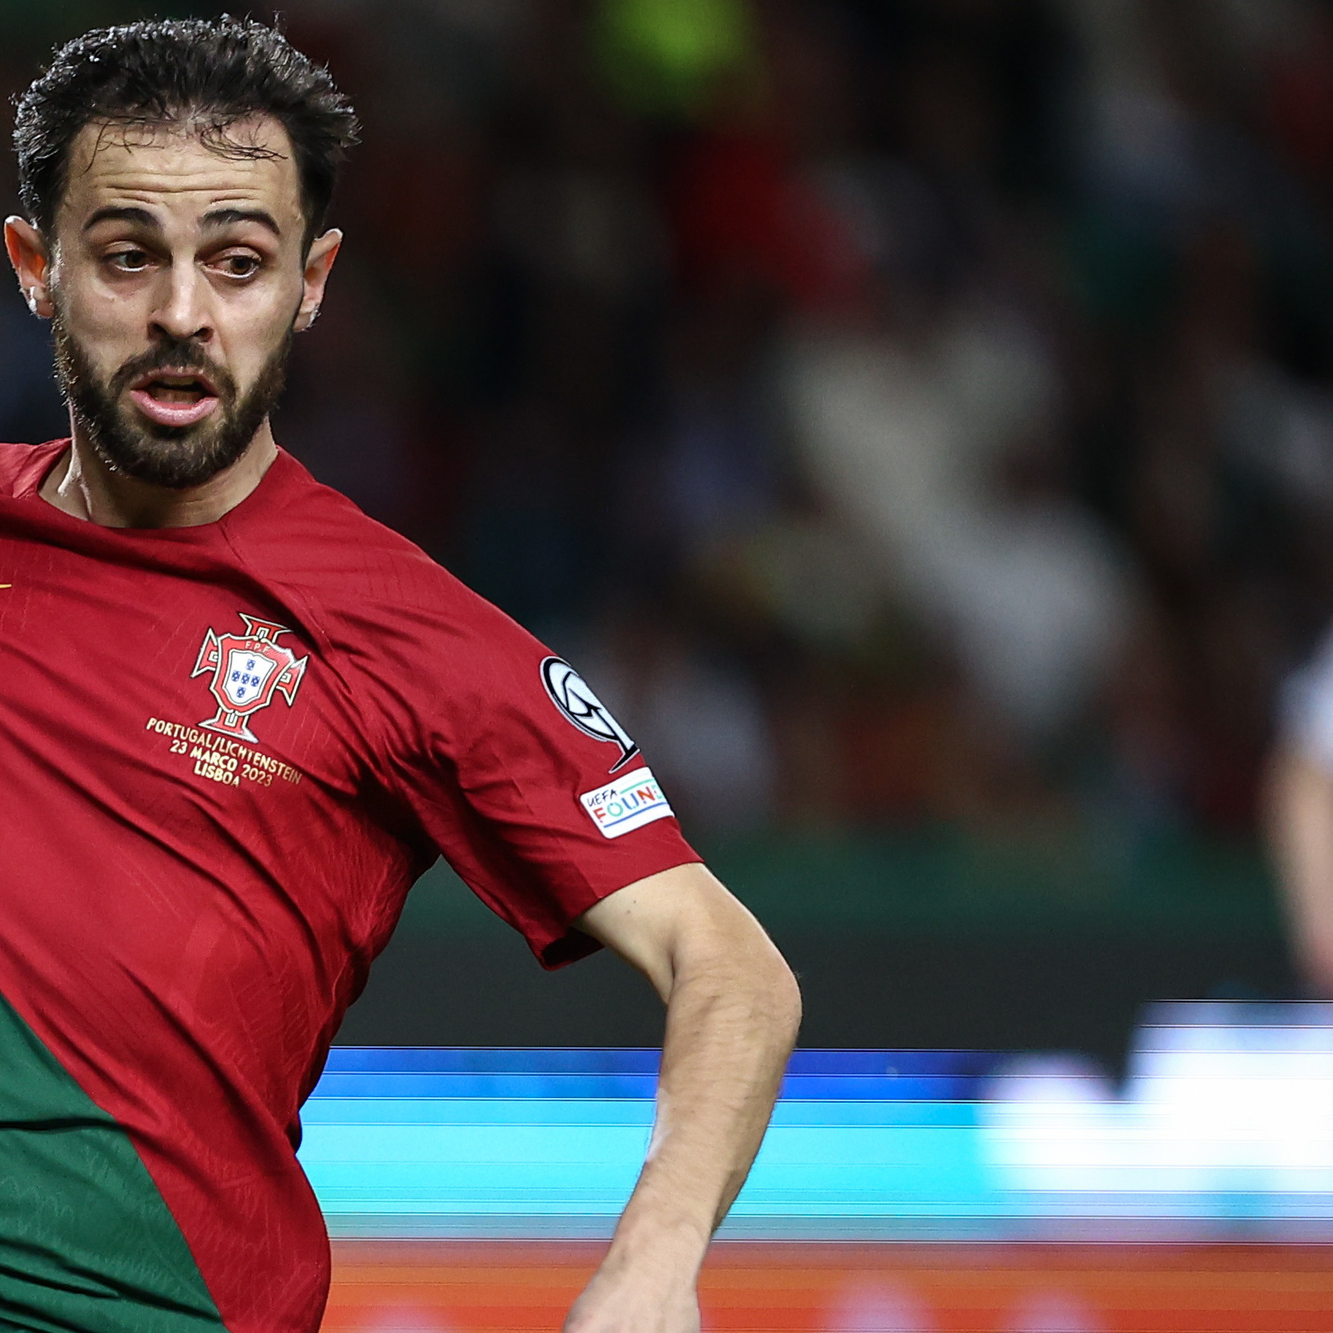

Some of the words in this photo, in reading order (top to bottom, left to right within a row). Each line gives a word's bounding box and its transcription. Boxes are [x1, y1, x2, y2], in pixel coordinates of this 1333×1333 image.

[146, 717, 302, 785] PORTUGAL/LICHTENSTEIN
[169, 739, 188, 755] 23
[240, 764, 273, 787] 2023
[194, 760, 240, 787] LISBOA
[587, 788, 618, 808] UEFA
